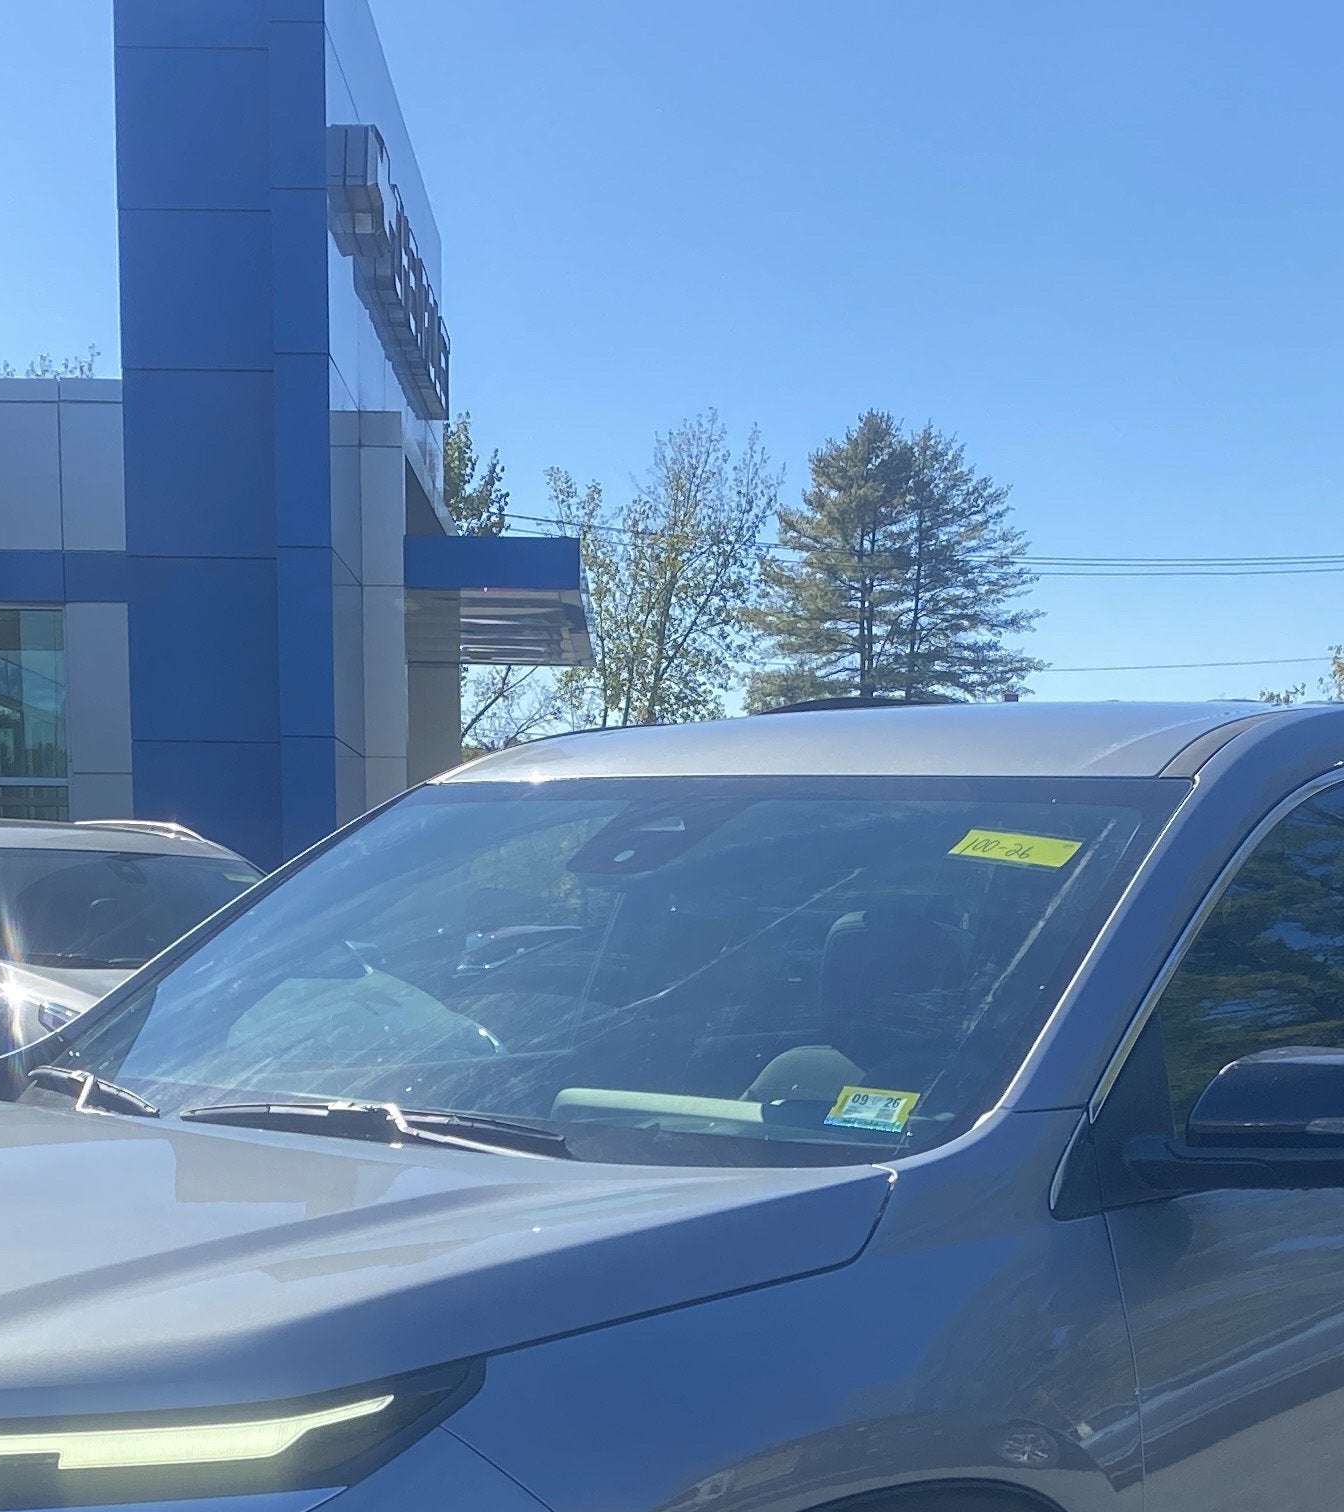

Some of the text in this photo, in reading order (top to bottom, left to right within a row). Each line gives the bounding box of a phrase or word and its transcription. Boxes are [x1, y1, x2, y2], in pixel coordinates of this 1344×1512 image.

[961, 837, 1034, 859] 100-26
[852, 1094, 901, 1108] 09 26
